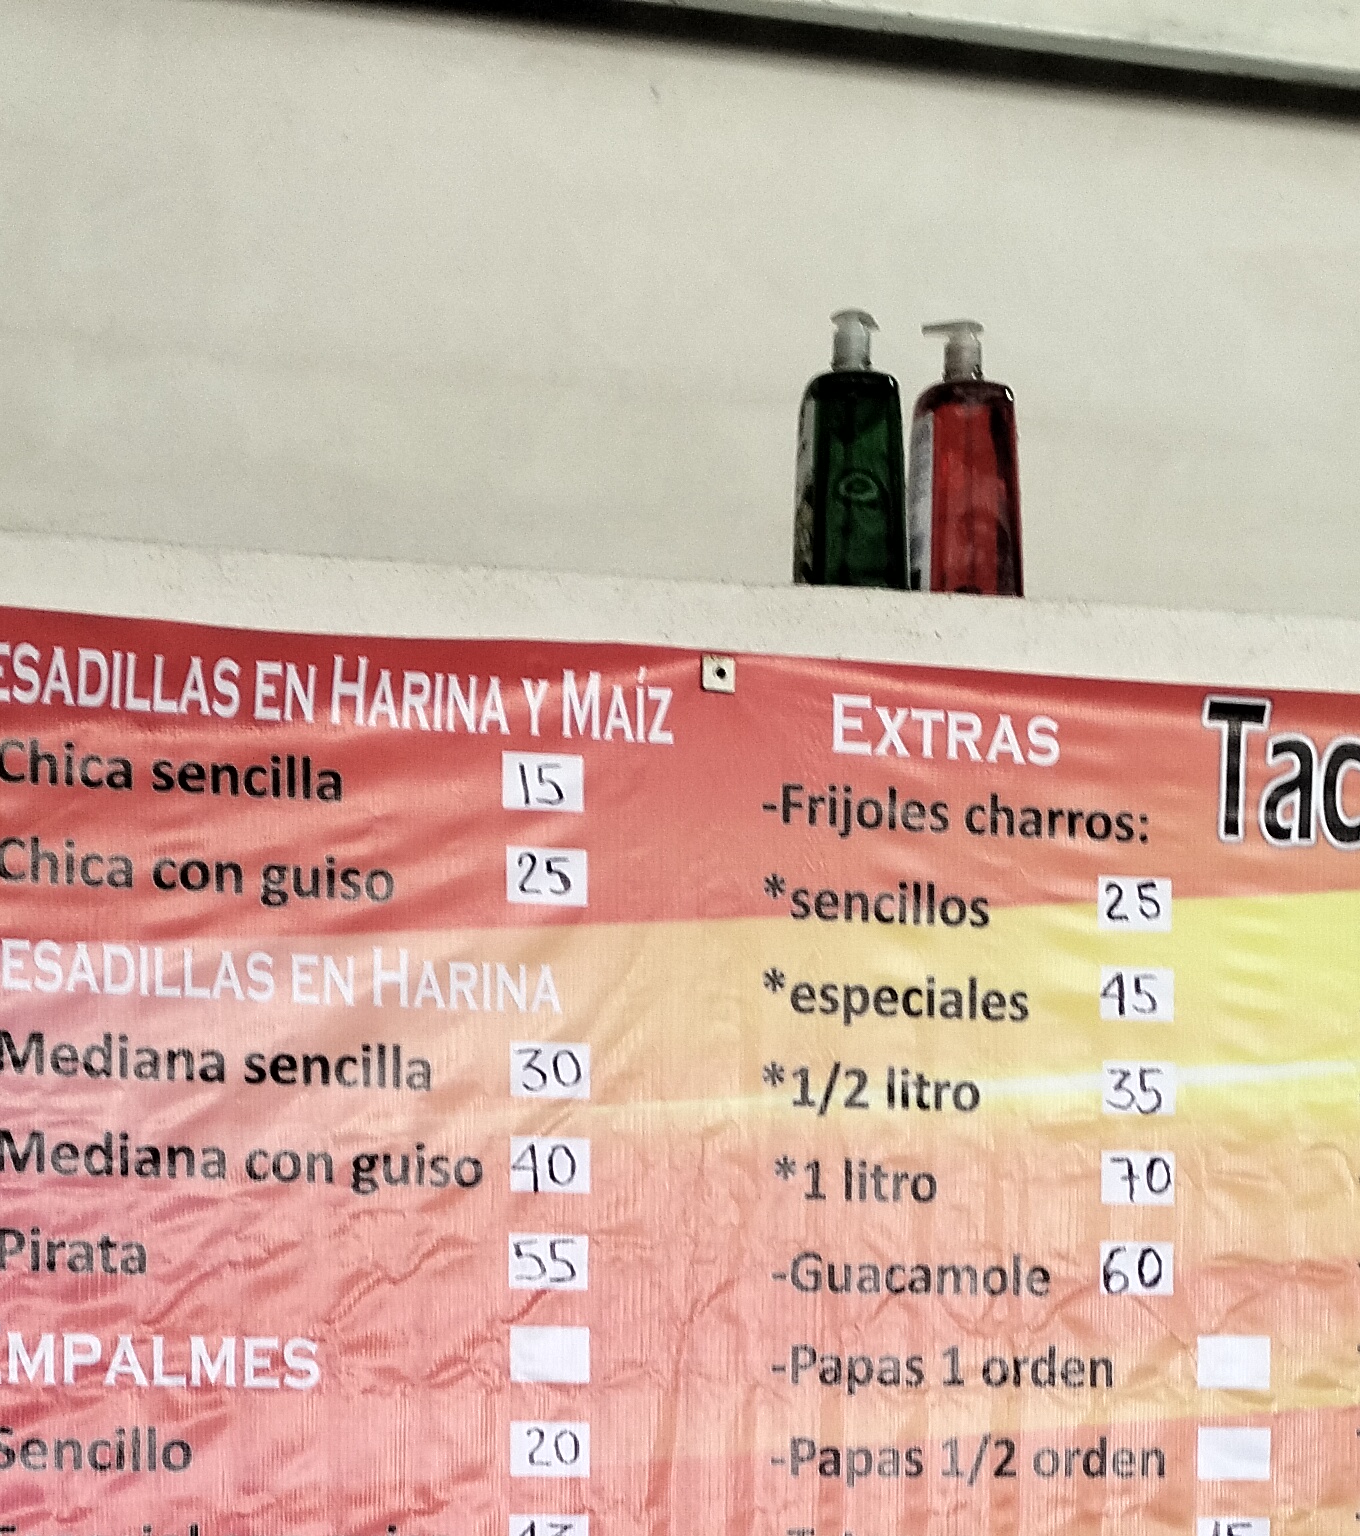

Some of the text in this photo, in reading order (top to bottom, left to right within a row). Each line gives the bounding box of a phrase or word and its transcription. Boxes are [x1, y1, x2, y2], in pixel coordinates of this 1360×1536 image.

[254, 661, 314, 723] EN
[331, 656, 509, 736] HARINA
[521, 676, 551, 736] Y
[562, 665, 674, 745] MAÍZ
[832, 694, 1060, 767] EXTRAS
[152, 751, 343, 802] sencilla
[517, 762, 564, 806] 15
[964, 793, 1150, 844] charros:
[1105, 881, 1161, 922] 25
[292, 952, 353, 1005] EN
[371, 947, 562, 1013] HARINA
[1100, 971, 1156, 1016] 45
[244, 1040, 432, 1093] sencilla
[516, 1046, 582, 1091] 30
[887, 1066, 980, 1111] litro
[1106, 1068, 1162, 1113] 35
[246, 1146, 334, 1184] con
[351, 1137, 483, 1192] guiso
[844, 1159, 937, 1202] litro
[1110, 1156, 1171, 1202] 70
[513, 1239, 575, 1283] 55
[1102, 1246, 1162, 1295] 60
[942, 1349, 964, 1386] 1
[982, 1345, 1114, 1388] orden
[526, 1428, 581, 1466] 20
